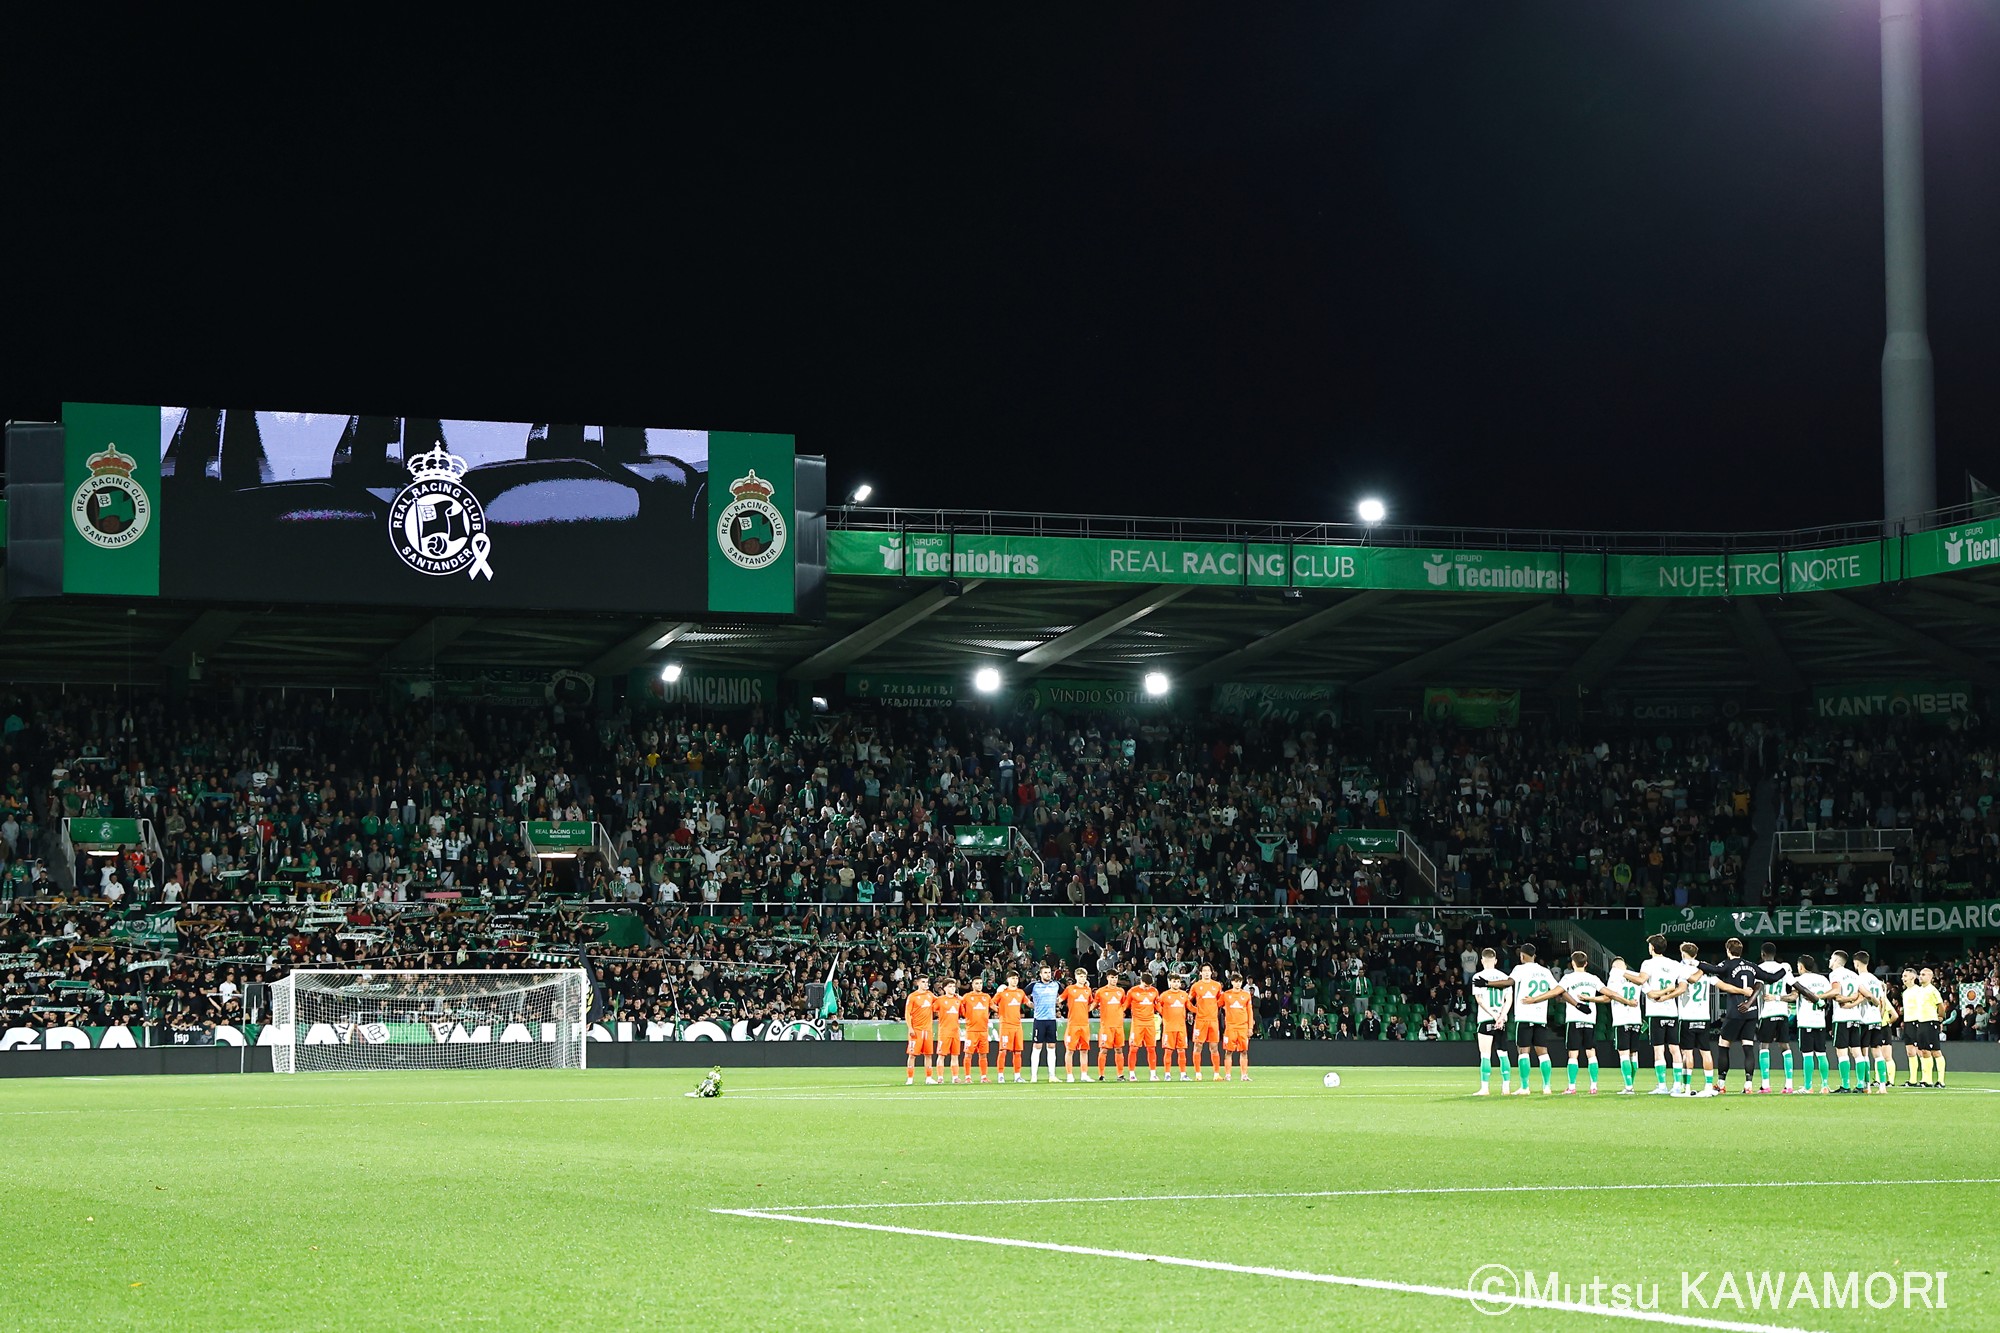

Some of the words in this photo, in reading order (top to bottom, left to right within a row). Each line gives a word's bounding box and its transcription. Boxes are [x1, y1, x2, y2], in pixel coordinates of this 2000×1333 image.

[77, 489, 92, 511] REAL
[91, 477, 131, 489] RACING
[131, 488, 146, 513] CLUB
[393, 496, 412, 528] REAL
[411, 482, 462, 498] RACING
[462, 498, 482, 531] CLUB
[721, 512, 734, 534] REAL
[734, 501, 768, 513] RACING
[769, 512, 783, 536] CLUB
[83, 525, 139, 544] SANTANDER
[914, 538, 943, 547] GRUPO
[402, 546, 473, 571] SANTANDER
[727, 547, 776, 565] SANTANDER
[913, 548, 1039, 575] Tecniobras
[1110, 549, 1174, 573] REAL
[1182, 552, 1285, 577] RACING
[1292, 555, 1355, 578] CLUB
[1455, 554, 1482, 562] GRUPO
[1455, 563, 1570, 589] Tecniobras
[1659, 563, 1780, 588] NUESTRO
[1791, 555, 1861, 583] NORTE
[1050, 688, 1101, 704] VINDIO
[1661, 917, 1716, 935] Dromedario
[1822, 903, 2000, 932] DROMEDARIO
[1528, 980, 1550, 998] 29
[1692, 981, 1709, 1002] 21
[1741, 974, 1748, 990] 1
[1847, 983, 1855, 998] 2
[1487, 985, 1504, 1008] 10
